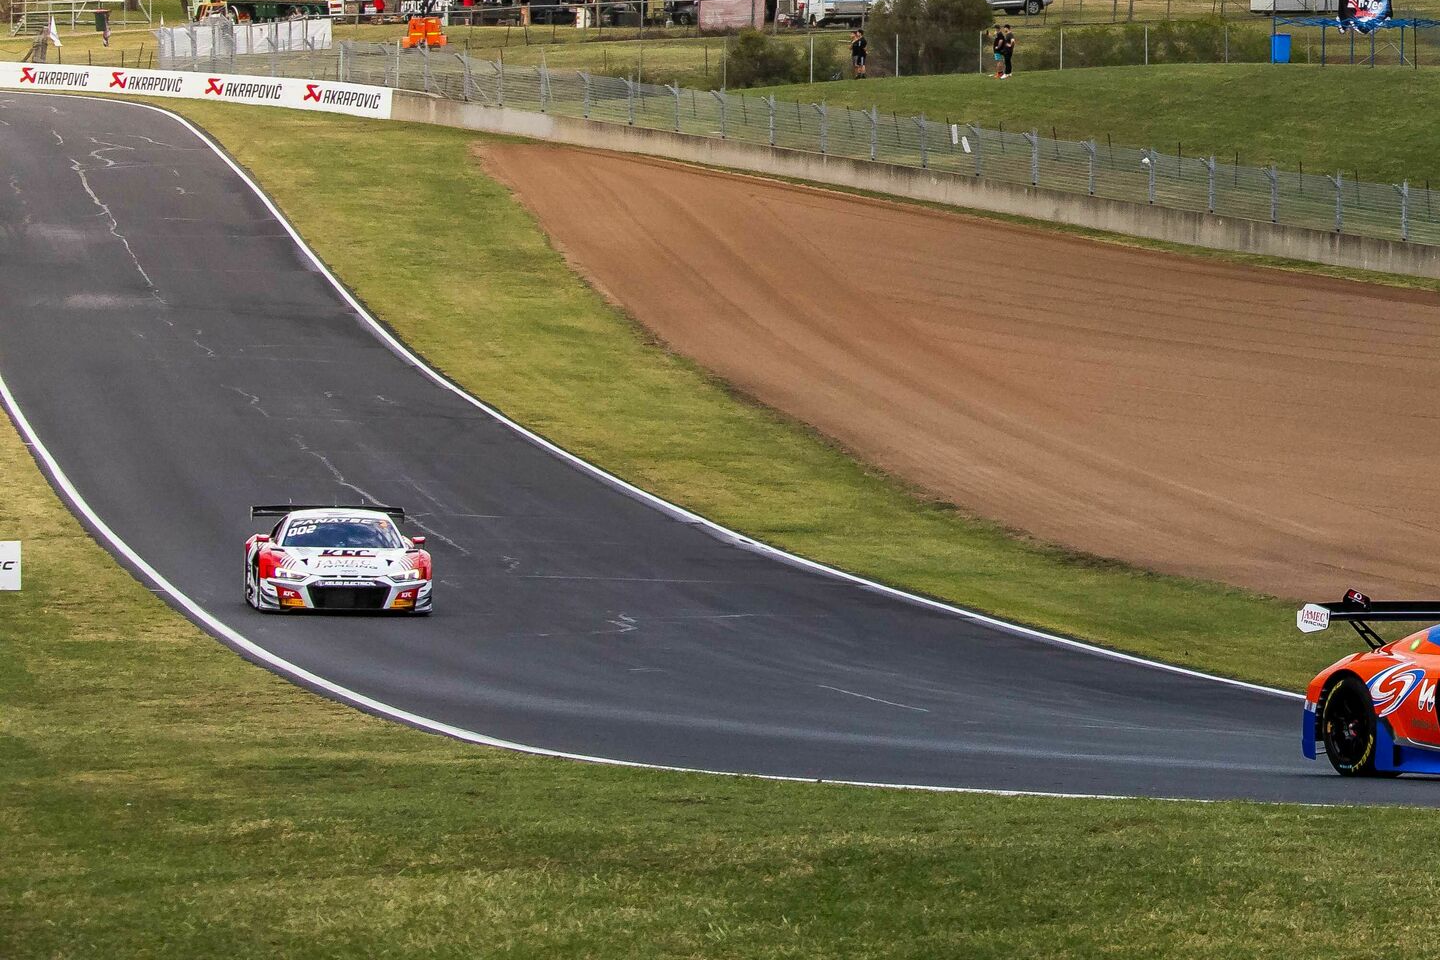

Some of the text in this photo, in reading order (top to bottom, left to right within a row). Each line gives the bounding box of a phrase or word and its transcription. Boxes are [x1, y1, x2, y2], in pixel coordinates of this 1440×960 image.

[292, 518, 374, 528] FANATEC
[287, 525, 317, 537] 002
[1303, 619, 1327, 628] RACING
